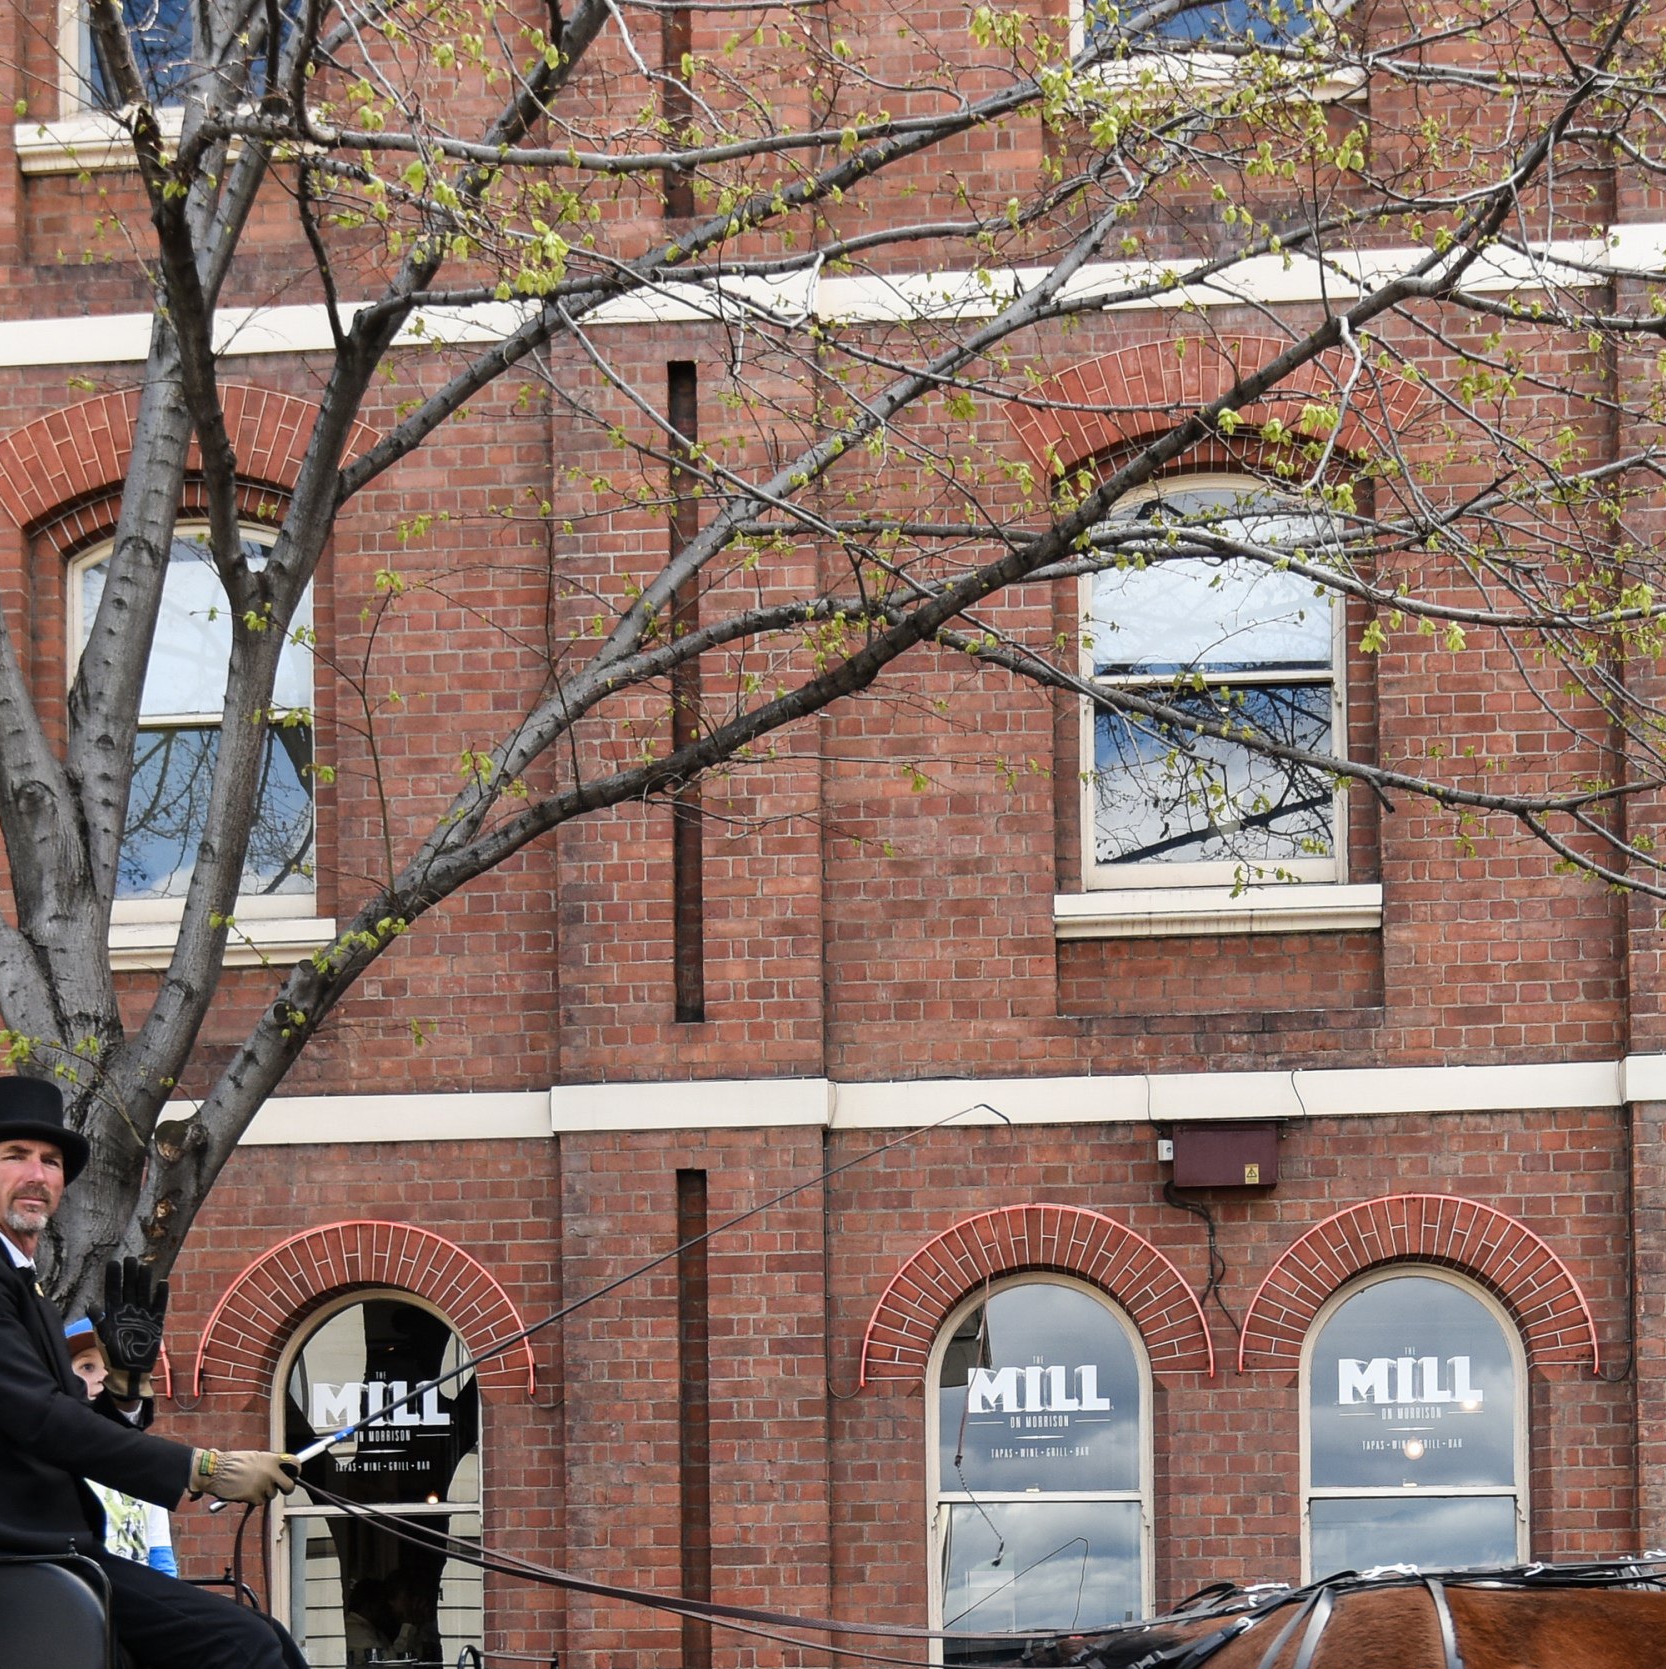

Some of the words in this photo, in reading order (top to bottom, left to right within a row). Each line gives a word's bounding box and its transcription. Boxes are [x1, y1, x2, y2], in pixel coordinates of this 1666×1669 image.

[1338, 1356, 1483, 1405] MILL
[967, 1365, 1110, 1413] MILL
[313, 1381, 451, 1428] MILL
[1381, 1408, 1393, 1420] ON
[1397, 1407, 1442, 1420] MORRISON
[1010, 1416, 1021, 1429] ON
[1025, 1415, 1069, 1428] MORRISON
[368, 1429, 411, 1442] MORRISON
[1362, 1440, 1385, 1451] TAPAS
[1448, 1438, 1463, 1449] BAR
[991, 1448, 1013, 1459] TAPAS
[1046, 1447, 1068, 1457] GRILL
[1075, 1446, 1090, 1456] BAR
[335, 1462, 357, 1473] TAPAS
[388, 1461, 410, 1471] GRILL
[416, 1461, 431, 1471] BAR
